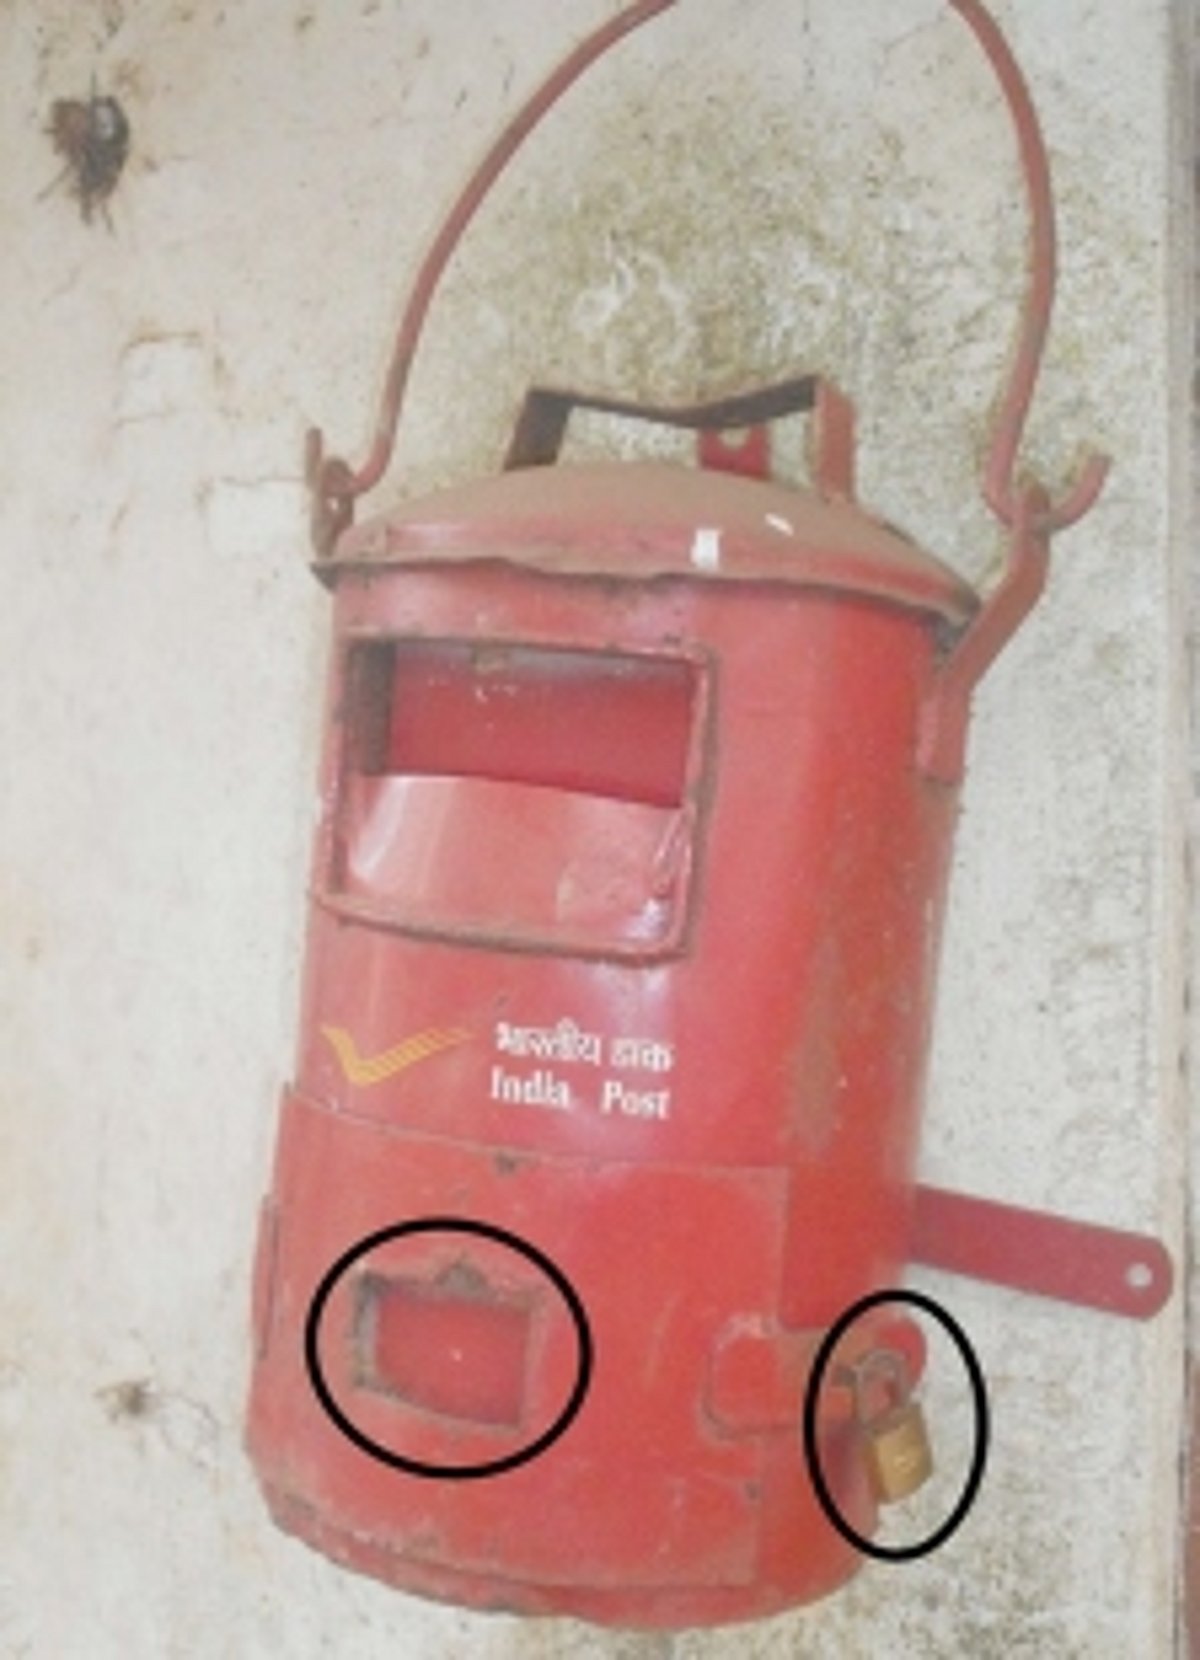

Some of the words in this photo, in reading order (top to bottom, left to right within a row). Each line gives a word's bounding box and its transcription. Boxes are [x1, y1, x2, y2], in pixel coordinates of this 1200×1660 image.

[496, 1017, 601, 1066] भारतीय
[611, 1038, 674, 1072] डाक
[491, 1065, 569, 1109] India
[603, 1080, 670, 1119] Post
